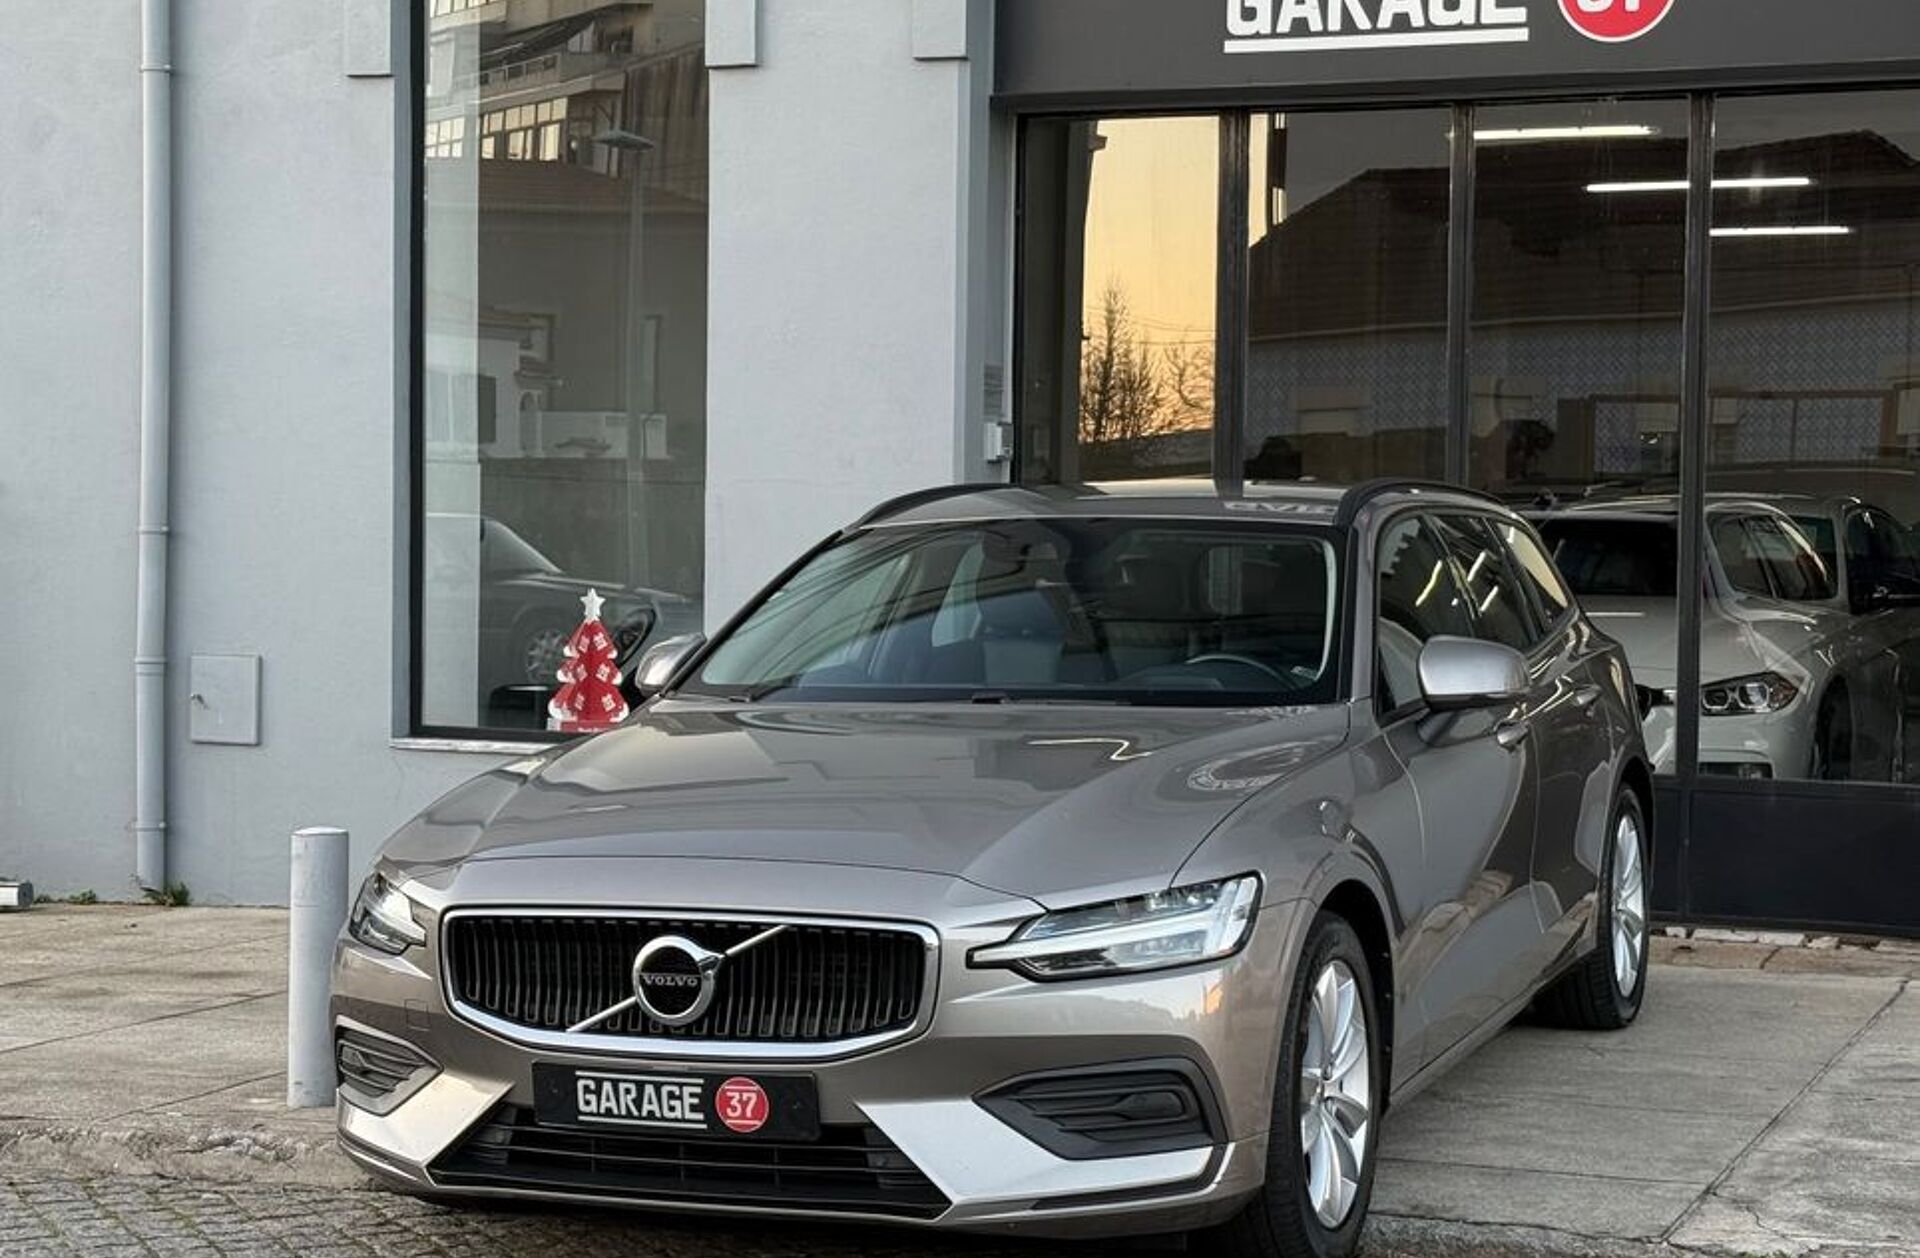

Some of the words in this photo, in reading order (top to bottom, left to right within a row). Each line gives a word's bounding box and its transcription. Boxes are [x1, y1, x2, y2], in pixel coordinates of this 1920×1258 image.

[642, 975, 699, 987] VOLVO
[577, 1079, 704, 1120] GARAGE
[726, 1091, 757, 1118] 37
